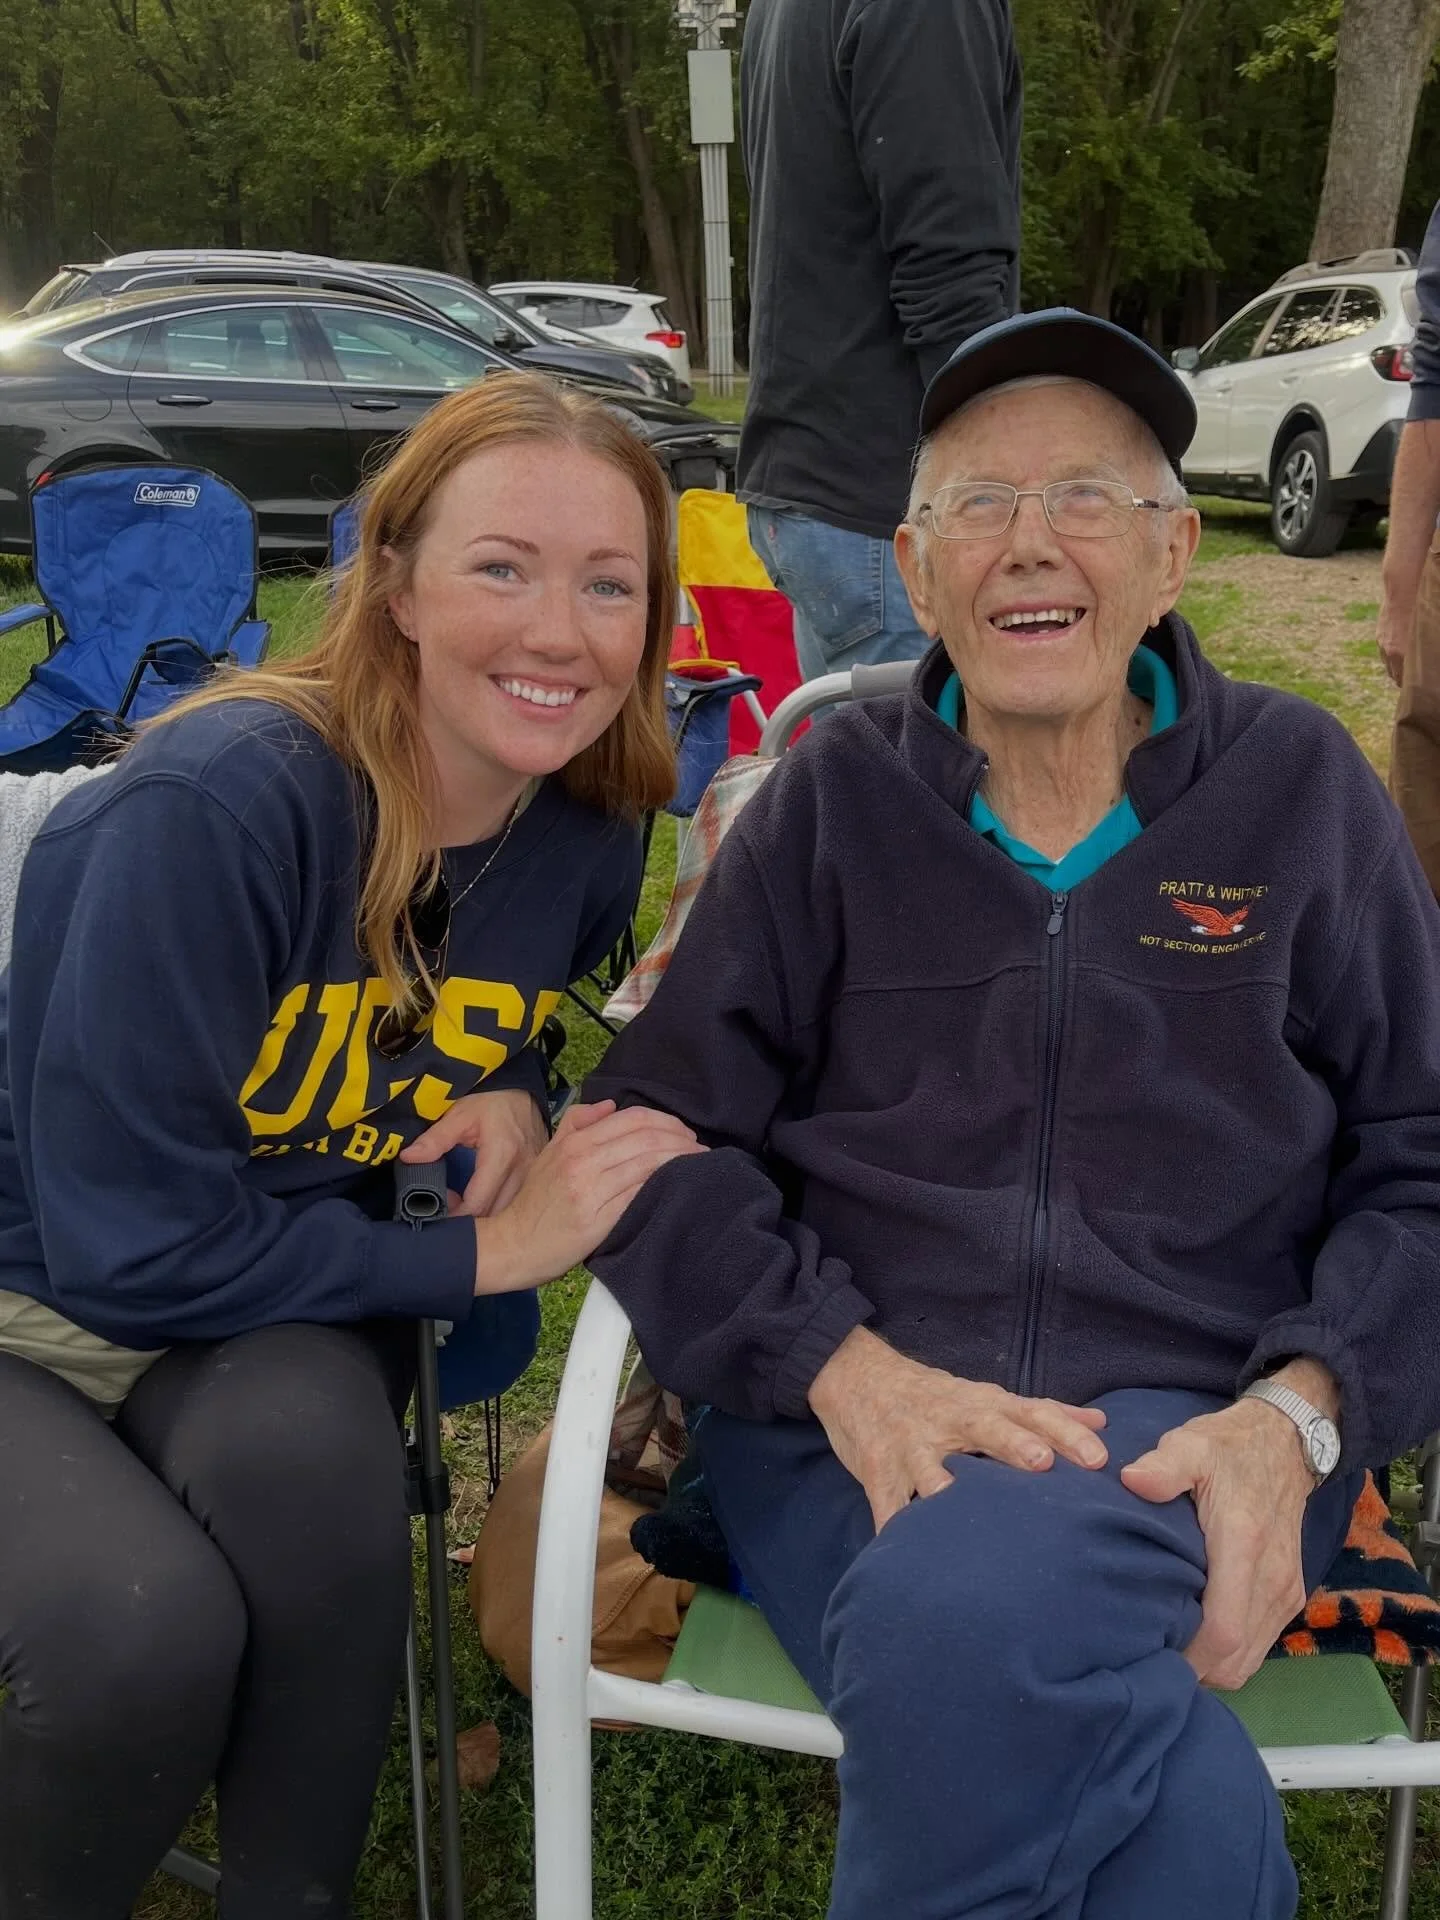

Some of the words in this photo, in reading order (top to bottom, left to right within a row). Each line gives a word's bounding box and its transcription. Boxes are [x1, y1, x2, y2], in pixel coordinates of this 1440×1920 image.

[140, 485, 186, 500] Coleman
[1159, 881, 1205, 896] PRATT
[1206, 884, 1216, 899] &
[1139, 935, 1161, 946] HOT
[1163, 938, 1208, 953] SECTION
[238, 976, 564, 1136] UCS
